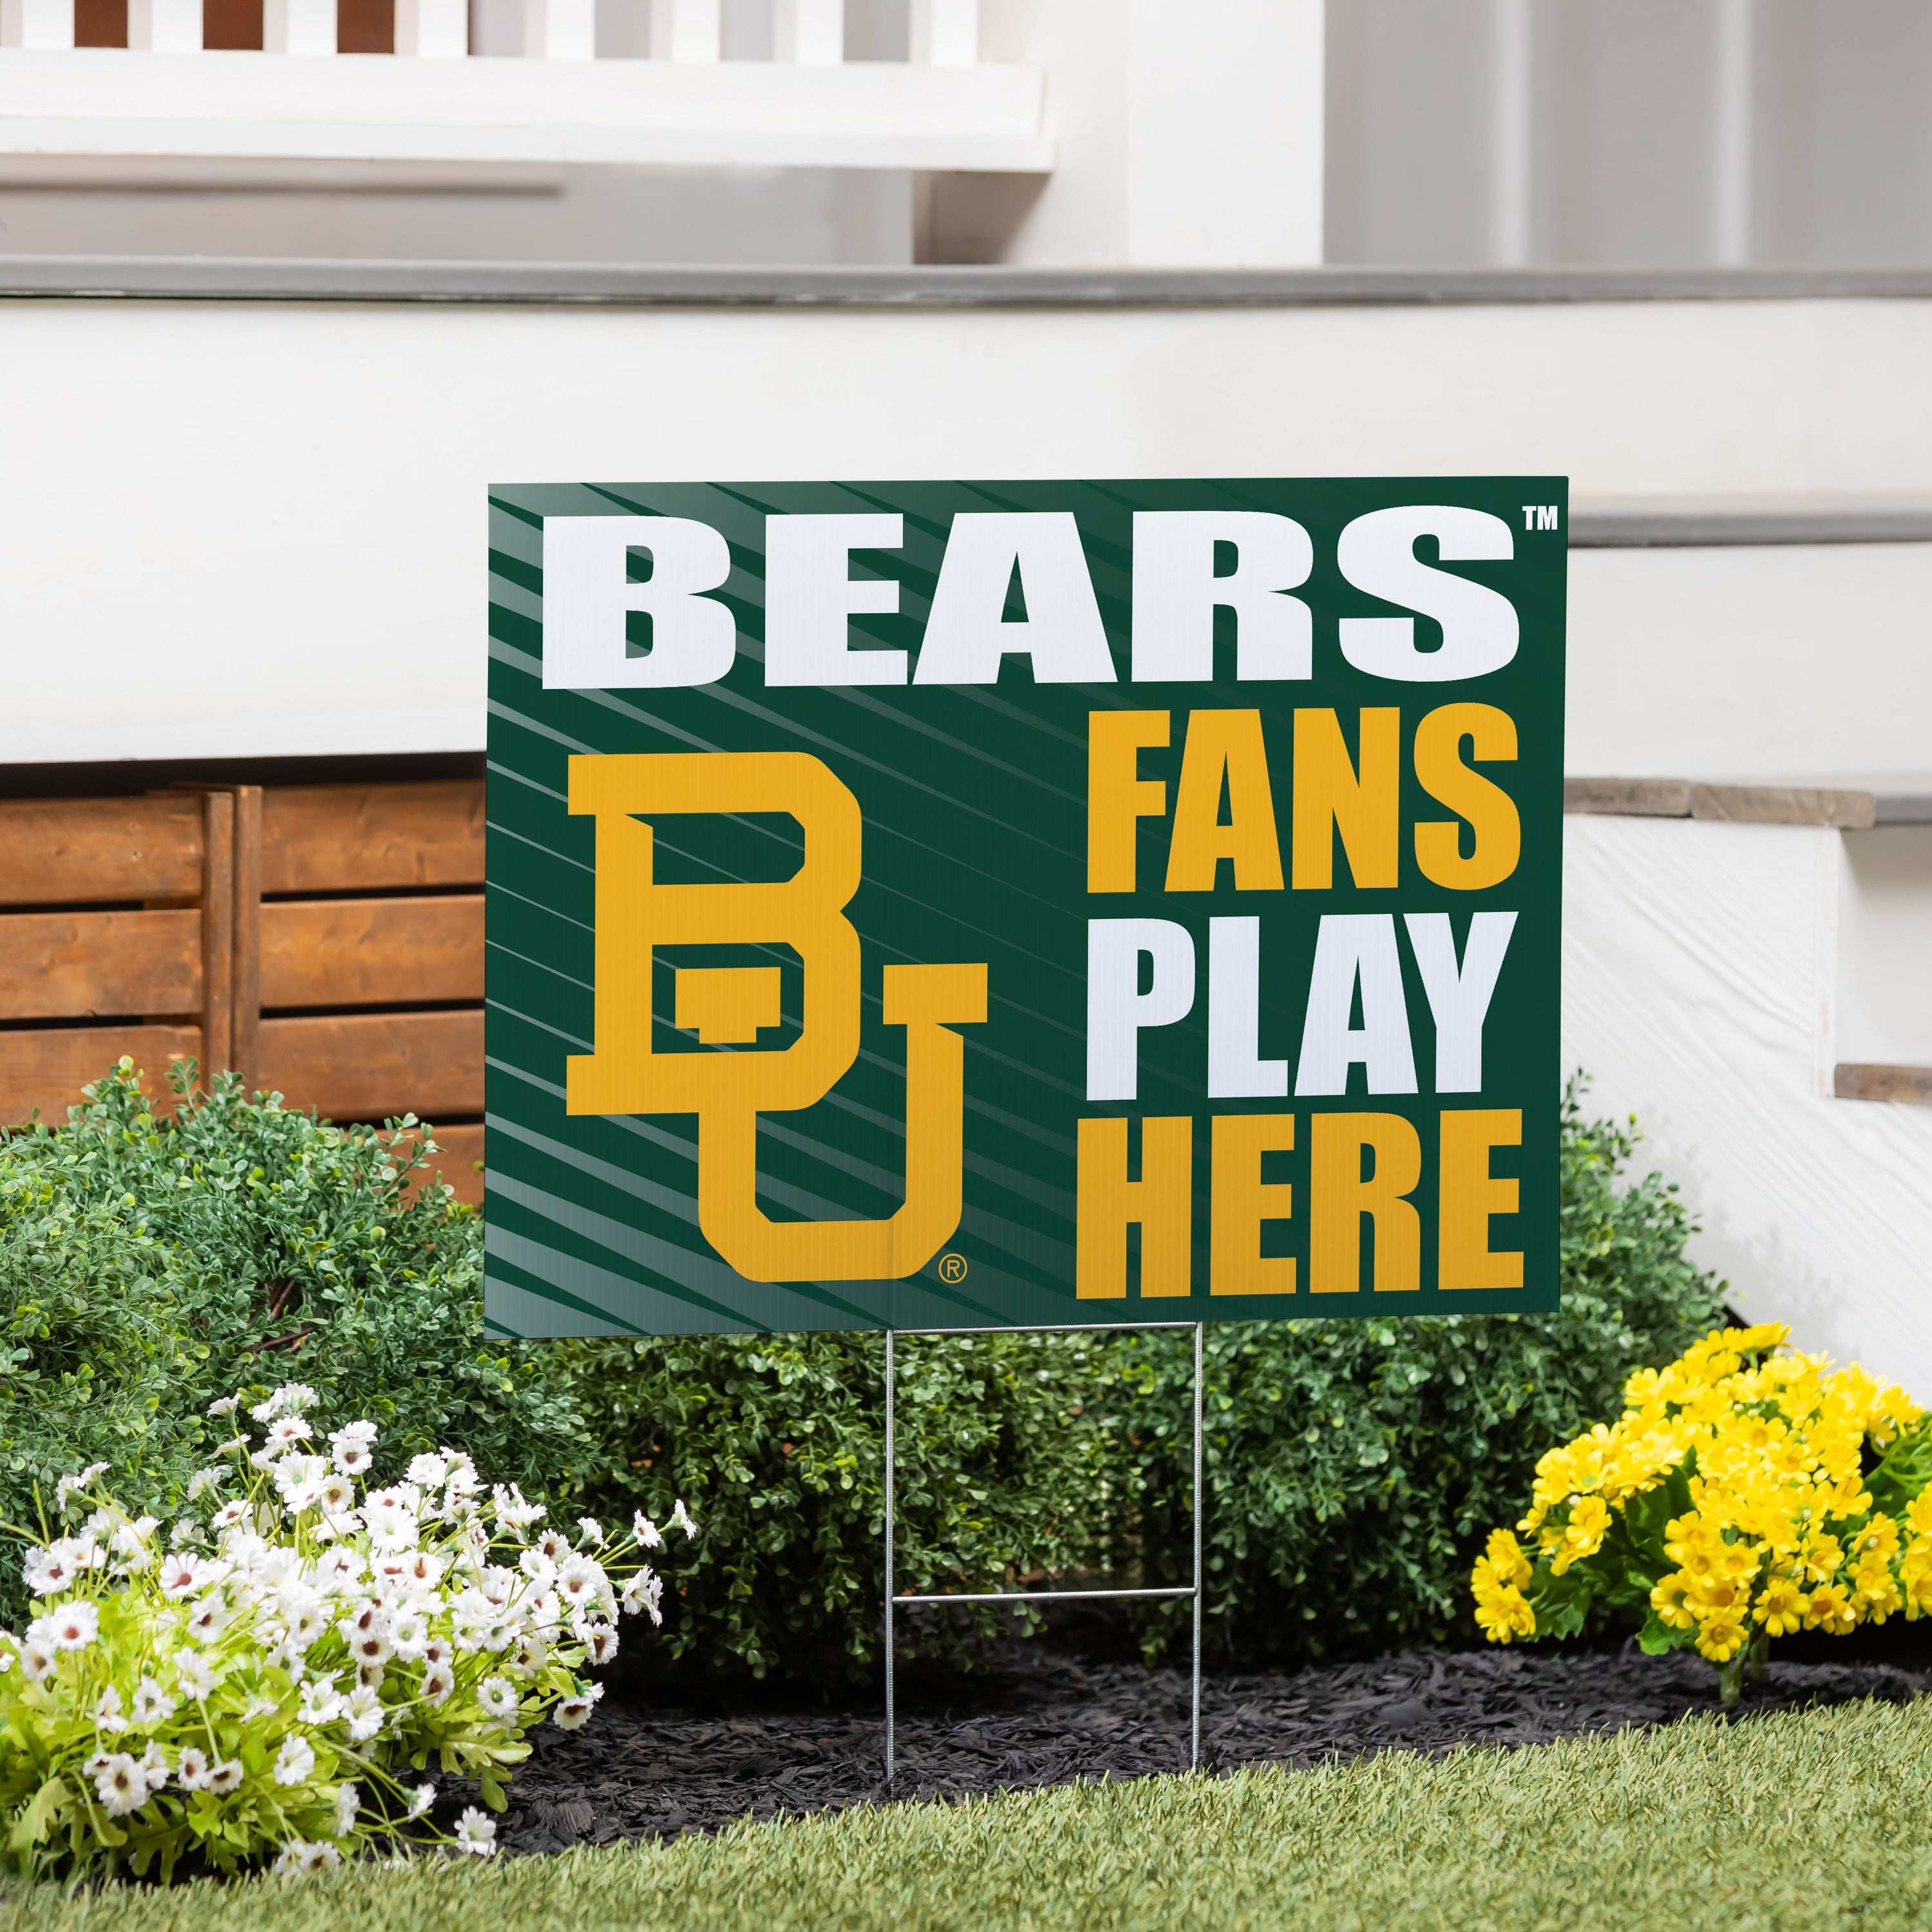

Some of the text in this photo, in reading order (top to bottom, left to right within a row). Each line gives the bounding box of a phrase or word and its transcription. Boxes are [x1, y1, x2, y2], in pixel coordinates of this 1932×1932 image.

[542, 505, 1520, 690] BEARS
[1087, 702, 1520, 893] FANS
[1086, 911, 1519, 1101] PLAY
[1076, 1108, 1524, 1300] HERE
